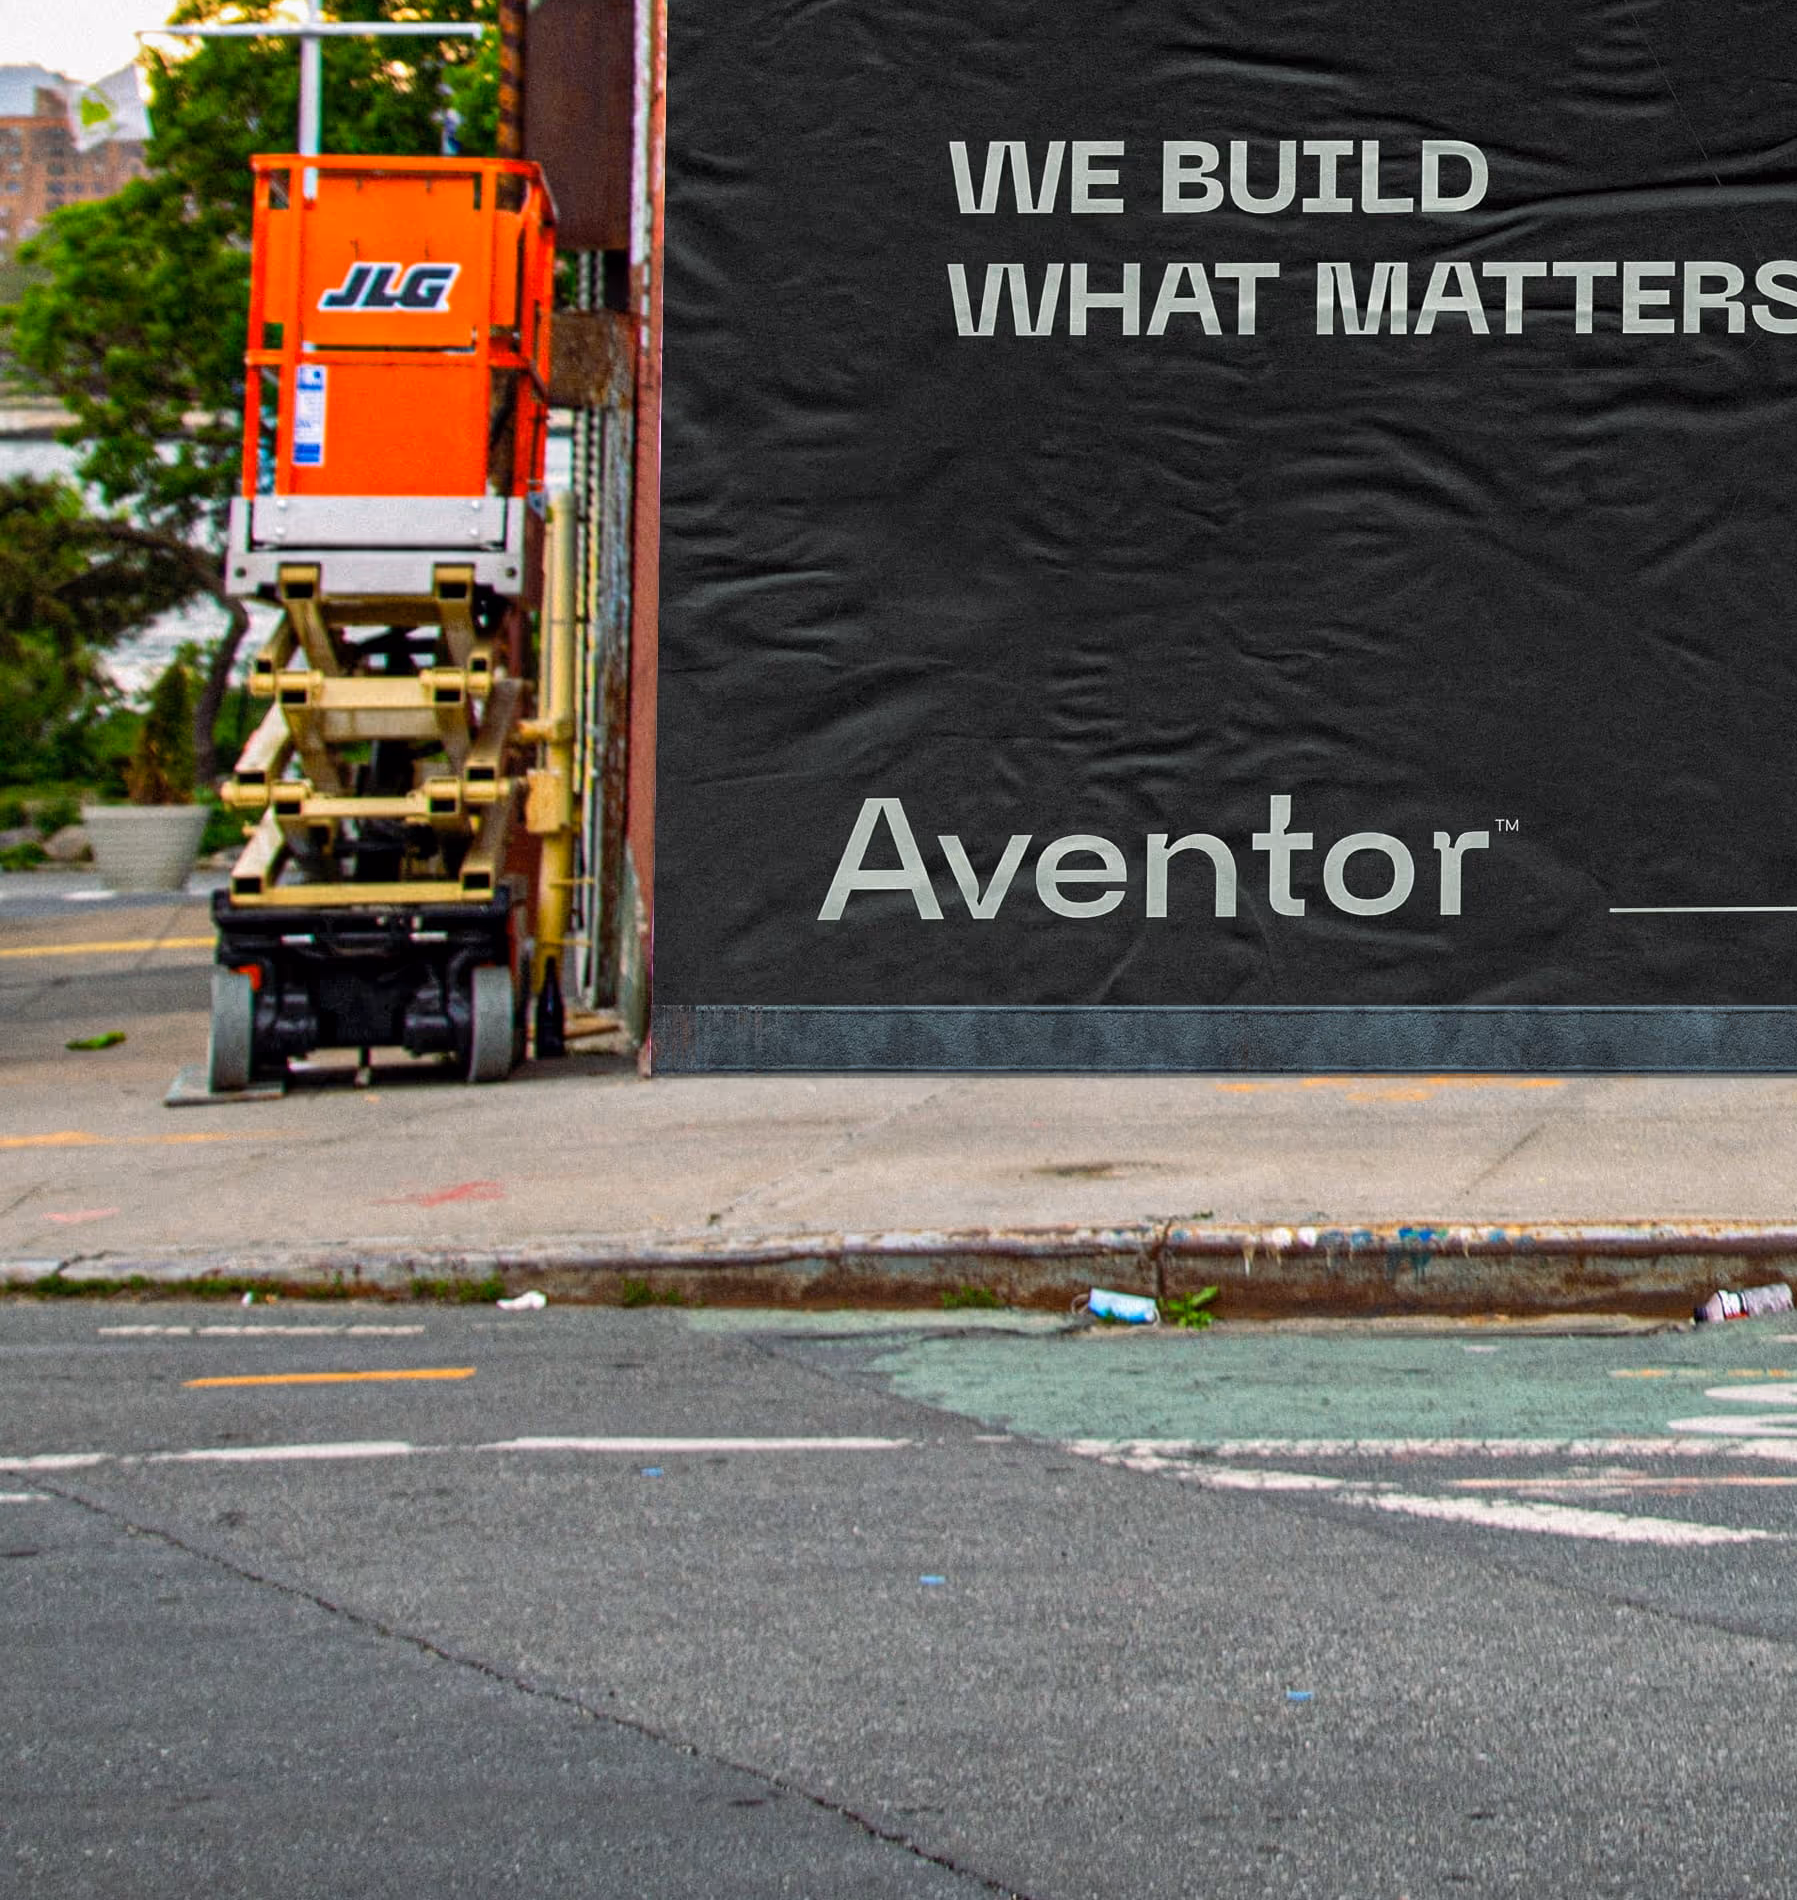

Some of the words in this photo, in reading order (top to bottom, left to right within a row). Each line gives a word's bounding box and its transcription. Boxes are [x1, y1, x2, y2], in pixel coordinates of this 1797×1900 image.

[948, 140, 1125, 214] WE
[1162, 139, 1489, 214] BUILD
[320, 264, 456, 310] JLG
[947, 261, 1281, 337] WHAT
[816, 794, 1490, 921] Aventor
